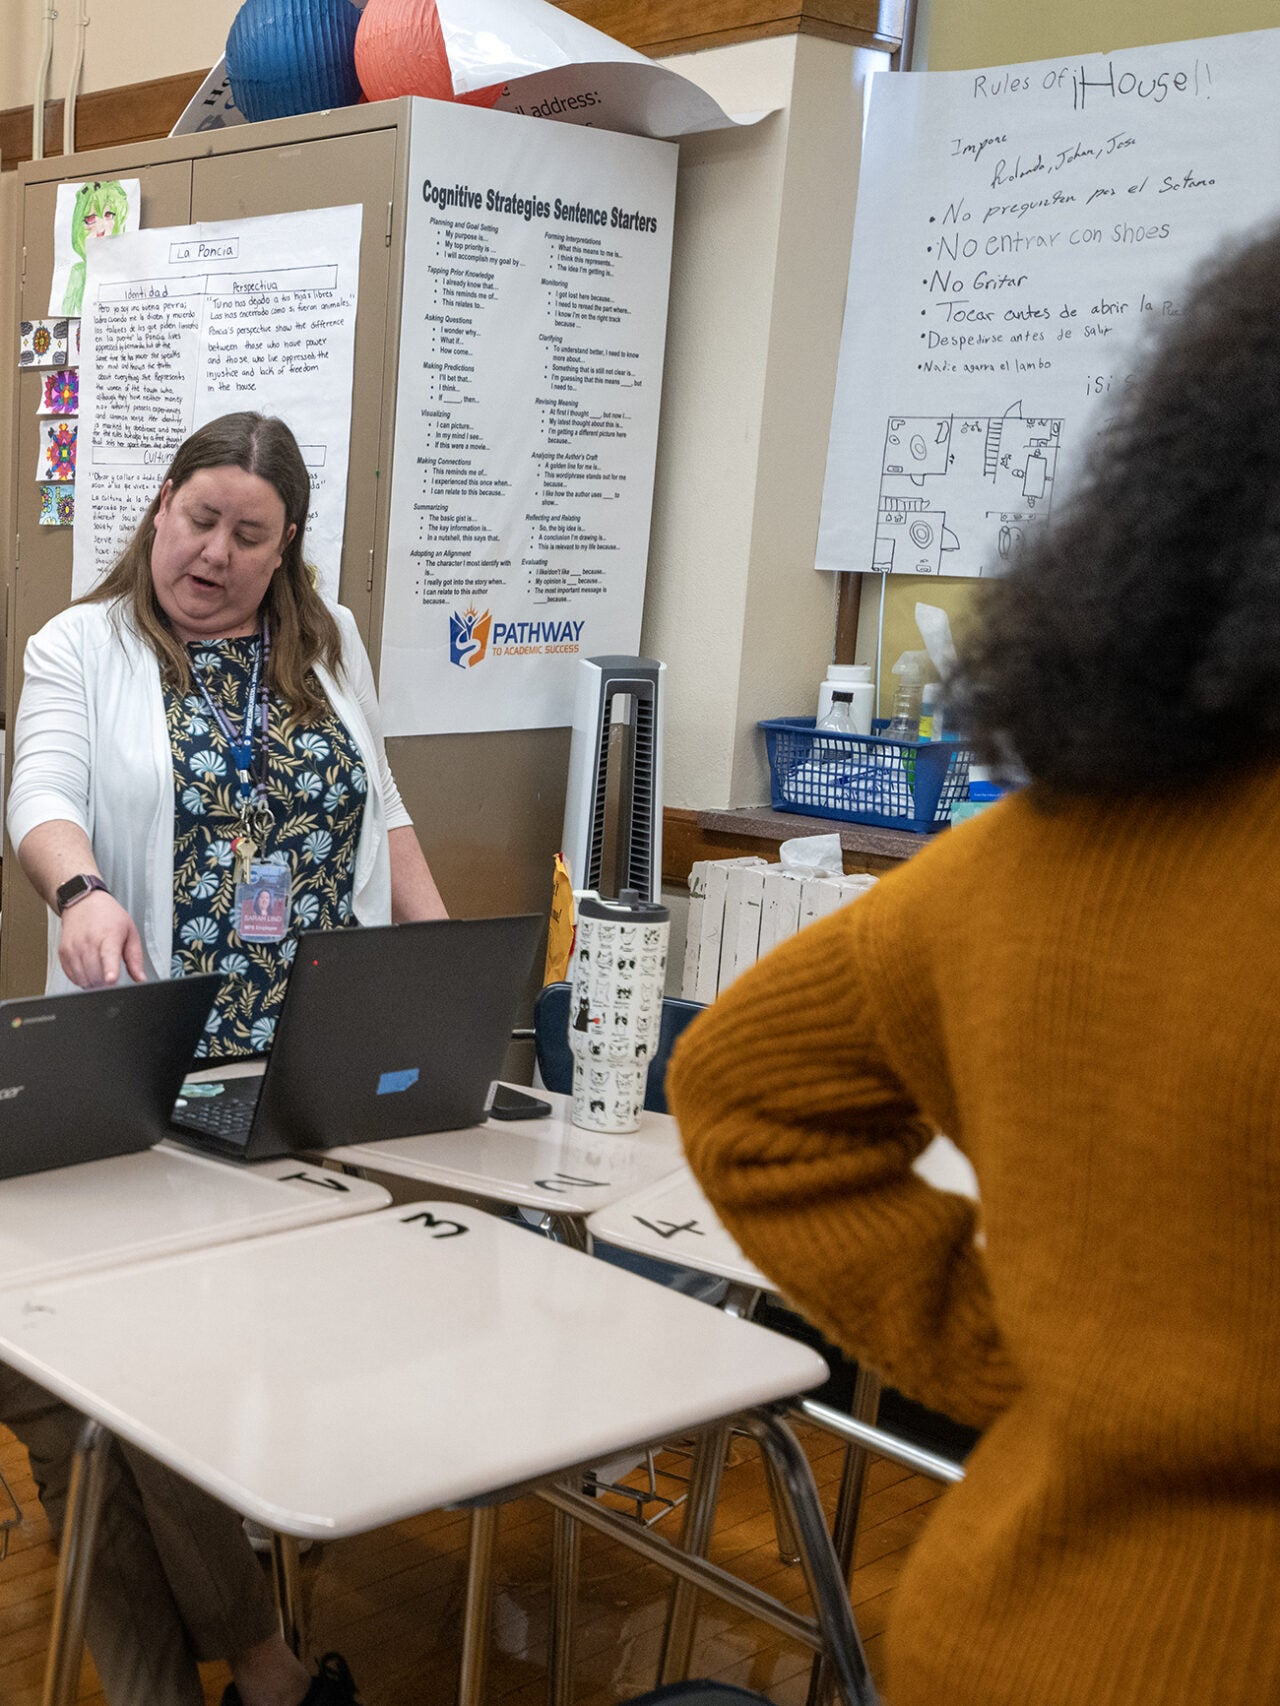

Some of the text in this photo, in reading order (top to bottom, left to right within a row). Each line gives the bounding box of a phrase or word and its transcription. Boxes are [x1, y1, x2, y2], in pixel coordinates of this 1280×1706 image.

[974, 73, 1030, 98] Rules
[1042, 67, 1068, 89] Of
[531, 90, 602, 118] address:
[422, 179, 658, 234] Cognitive Strategies Sentence Starters
[942, 197, 971, 225] No
[1127, 176, 1149, 193] el
[429, 217, 499, 234] Planning and Goal Setting
[445, 240, 453, 249] My
[454, 242, 463, 250] top
[464, 243, 483, 253] priority
[544, 232, 602, 246] Forming Interpretations
[937, 232, 978, 261] No
[985, 231, 1061, 256] entrar
[1069, 228, 1102, 245] con
[177, 247, 190, 259] La
[427, 265, 495, 281] Tapping Prior Knowledge
[929, 270, 1028, 292] No Gritar
[124, 284, 168, 300] Identidad
[232, 280, 278, 294] Perspectiva
[935, 300, 995, 322] Tocar
[1004, 304, 1051, 321] antes
[1059, 304, 1077, 319] de
[1091, 298, 1128, 315] abrir
[1140, 294, 1153, 313] la
[275, 323, 293, 332] show
[295, 320, 306, 329] the
[310, 318, 345, 330] difference
[424, 313, 472, 325] Asking Questions
[208, 341, 238, 352] between
[245, 340, 263, 349] those
[267, 339, 280, 349] who
[306, 337, 328, 350] power
[928, 330, 1003, 350] Despedirse
[1010, 331, 1045, 342] antes
[1057, 328, 1072, 341] de
[207, 363, 319, 380] injustice and lack of freedom
[423, 361, 475, 372] Making Predictions
[1000, 360, 1010, 371] el
[219, 382, 230, 391] the
[492, 620, 586, 645] PATHWAY
[492, 644, 580, 656] TO ACADEMIC SUCCESS
[400, 1212, 470, 1239] 3
[632, 1213, 707, 1240] 4
